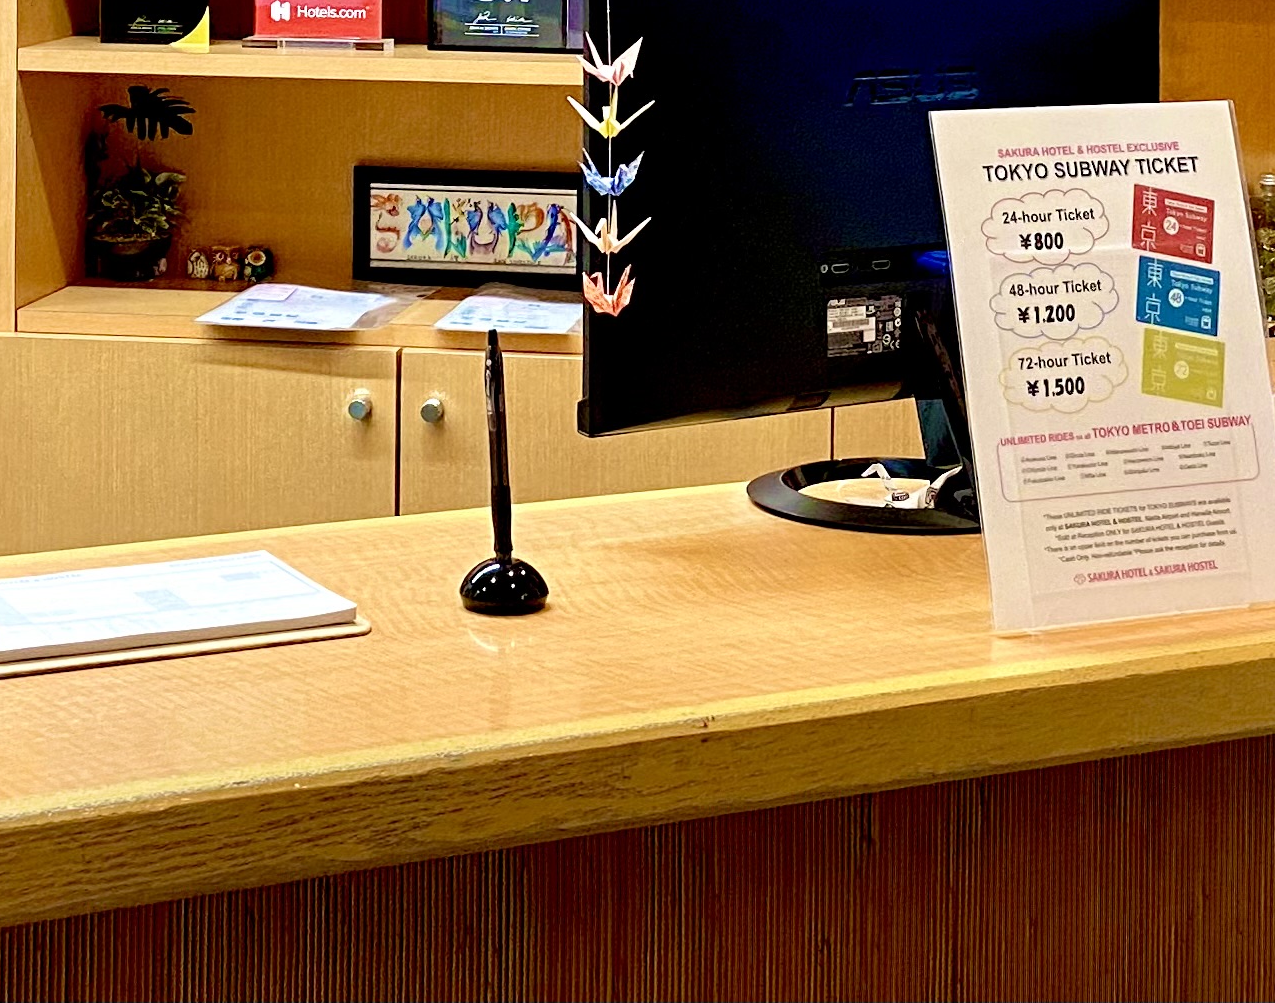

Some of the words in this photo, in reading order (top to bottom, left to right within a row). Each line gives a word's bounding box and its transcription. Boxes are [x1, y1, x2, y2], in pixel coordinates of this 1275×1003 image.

[297, 5, 366, 19] Hotels.com
[998, 147, 1040, 158] SAKURA
[1042, 146, 1075, 156] HOTEL
[1077, 145, 1084, 155] &
[1086, 144, 1125, 154] HOSTEL
[1126, 141, 1180, 153] EXCLUSIVE
[982, 163, 1049, 182] TOKYO
[1054, 159, 1130, 178] SUBWAY
[1135, 156, 1199, 174] TICKET
[1002, 211, 1053, 224] 24-hour
[1056, 208, 1095, 222] Ticket
[1166, 219, 1177, 232] 24
[1009, 282, 1059, 296] 48-hour
[1062, 279, 1102, 294] Ticket
[1170, 292, 1182, 304] 48
[1018, 357, 1069, 370] 72-hour
[1071, 352, 1112, 366] Ticket
[1000, 434, 1047, 446] UNLIMITED
[1048, 432, 1075, 442] RIDES
[1092, 425, 1130, 439] TOKYO
[1207, 415, 1252, 428] SUBWAY
[1087, 570, 1121, 582] SAKURA
[1122, 567, 1147, 579] HOTEL
[1154, 563, 1186, 575] SAKURA
[1188, 560, 1218, 571] HOSTEL
